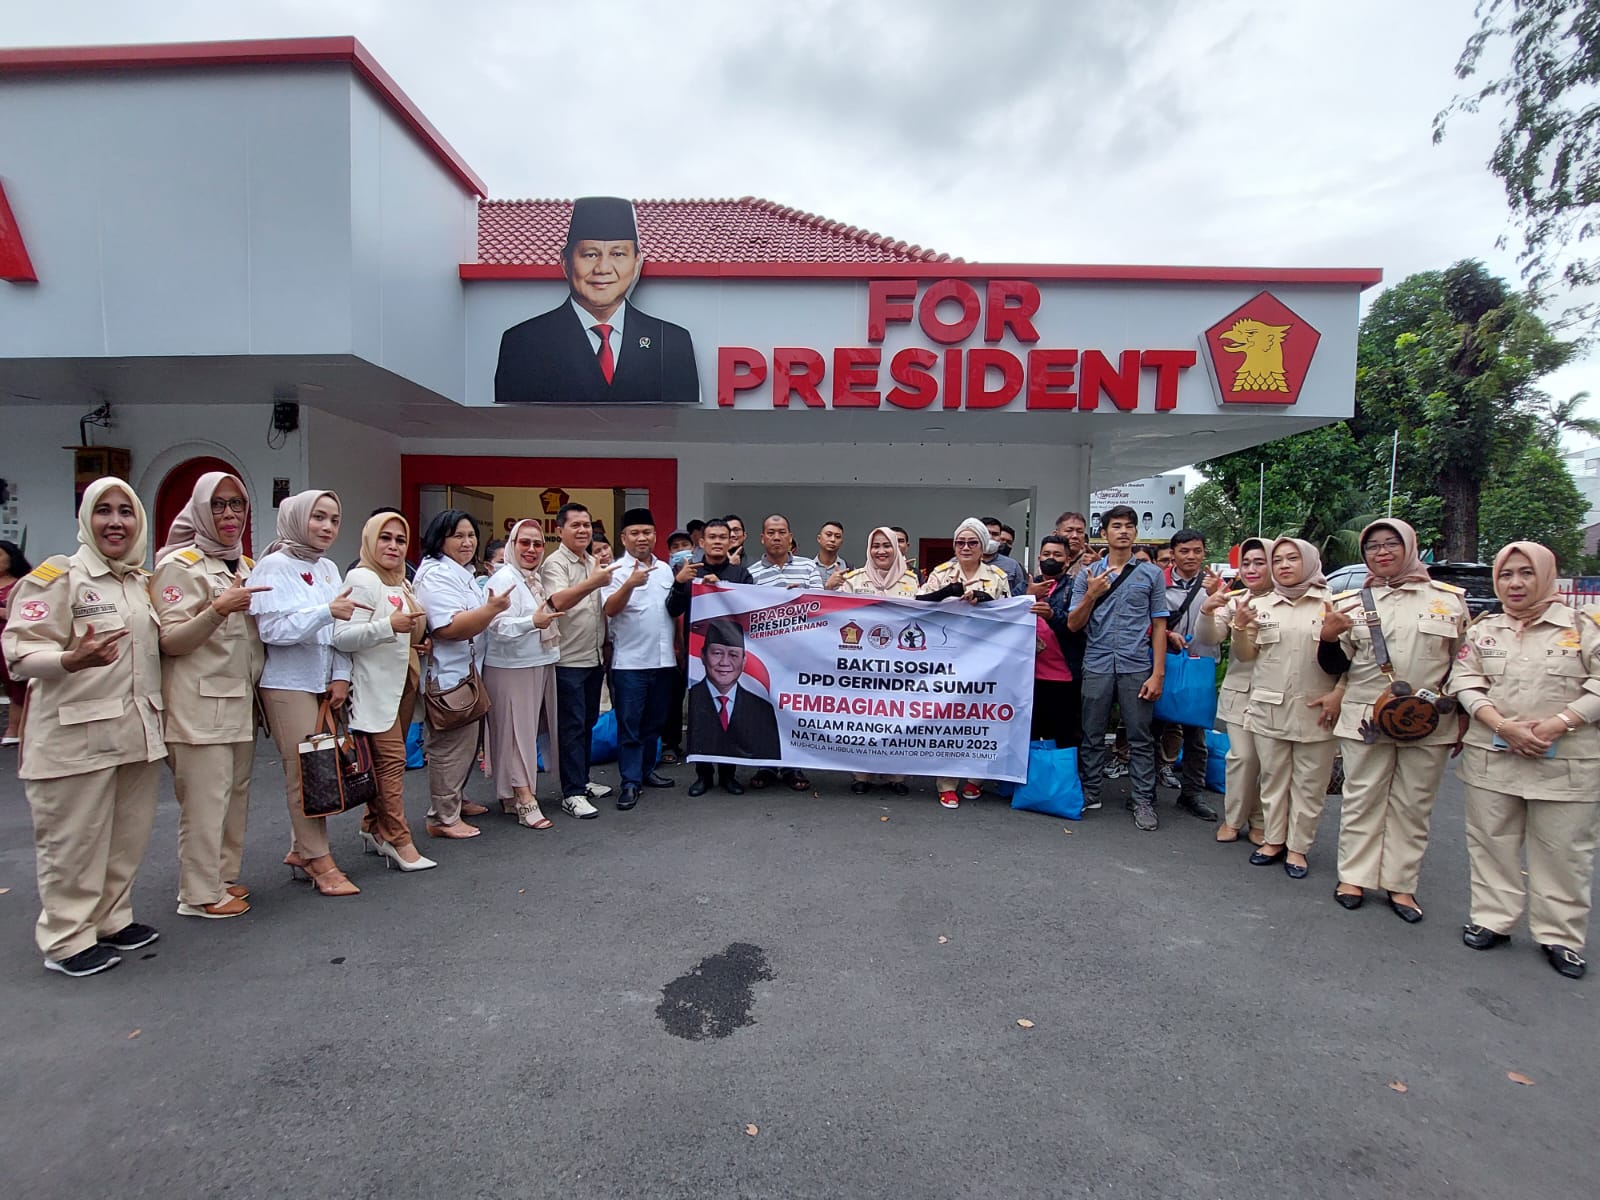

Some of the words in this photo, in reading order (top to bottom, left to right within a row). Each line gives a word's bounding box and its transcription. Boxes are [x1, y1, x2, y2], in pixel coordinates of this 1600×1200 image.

[867, 279, 1041, 345] FOR
[717, 346, 1197, 413] PRESIDENT
[750, 602, 820, 623] PRABOWO
[749, 628, 791, 640] GERINDRA
[792, 620, 829, 632] MENANG
[750, 614, 807, 633] PRESIDEN
[836, 657, 890, 673] BAKTI
[893, 660, 956, 675] SOSIAL
[798, 672, 834, 687] DPD
[838, 675, 929, 693] GERINDRA
[932, 680, 997, 695] SUMUT
[778, 693, 905, 718] PEMBAGIAN
[909, 701, 1014, 721] SEMBAKO
[798, 718, 844, 731] DALAM
[846, 721, 903, 735] RANGKA
[905, 725, 990, 737] MENYAMBUT
[791, 729, 833, 744] NATAL
[835, 734, 866, 746] 2022
[868, 736, 878, 747] &
[881, 738, 926, 749] TAHUN
[928, 738, 964, 750] BARU
[966, 739, 998, 751] 2023
[790, 741, 826, 751] MUSHOLLA
[972, 752, 998, 761] SUMUT
